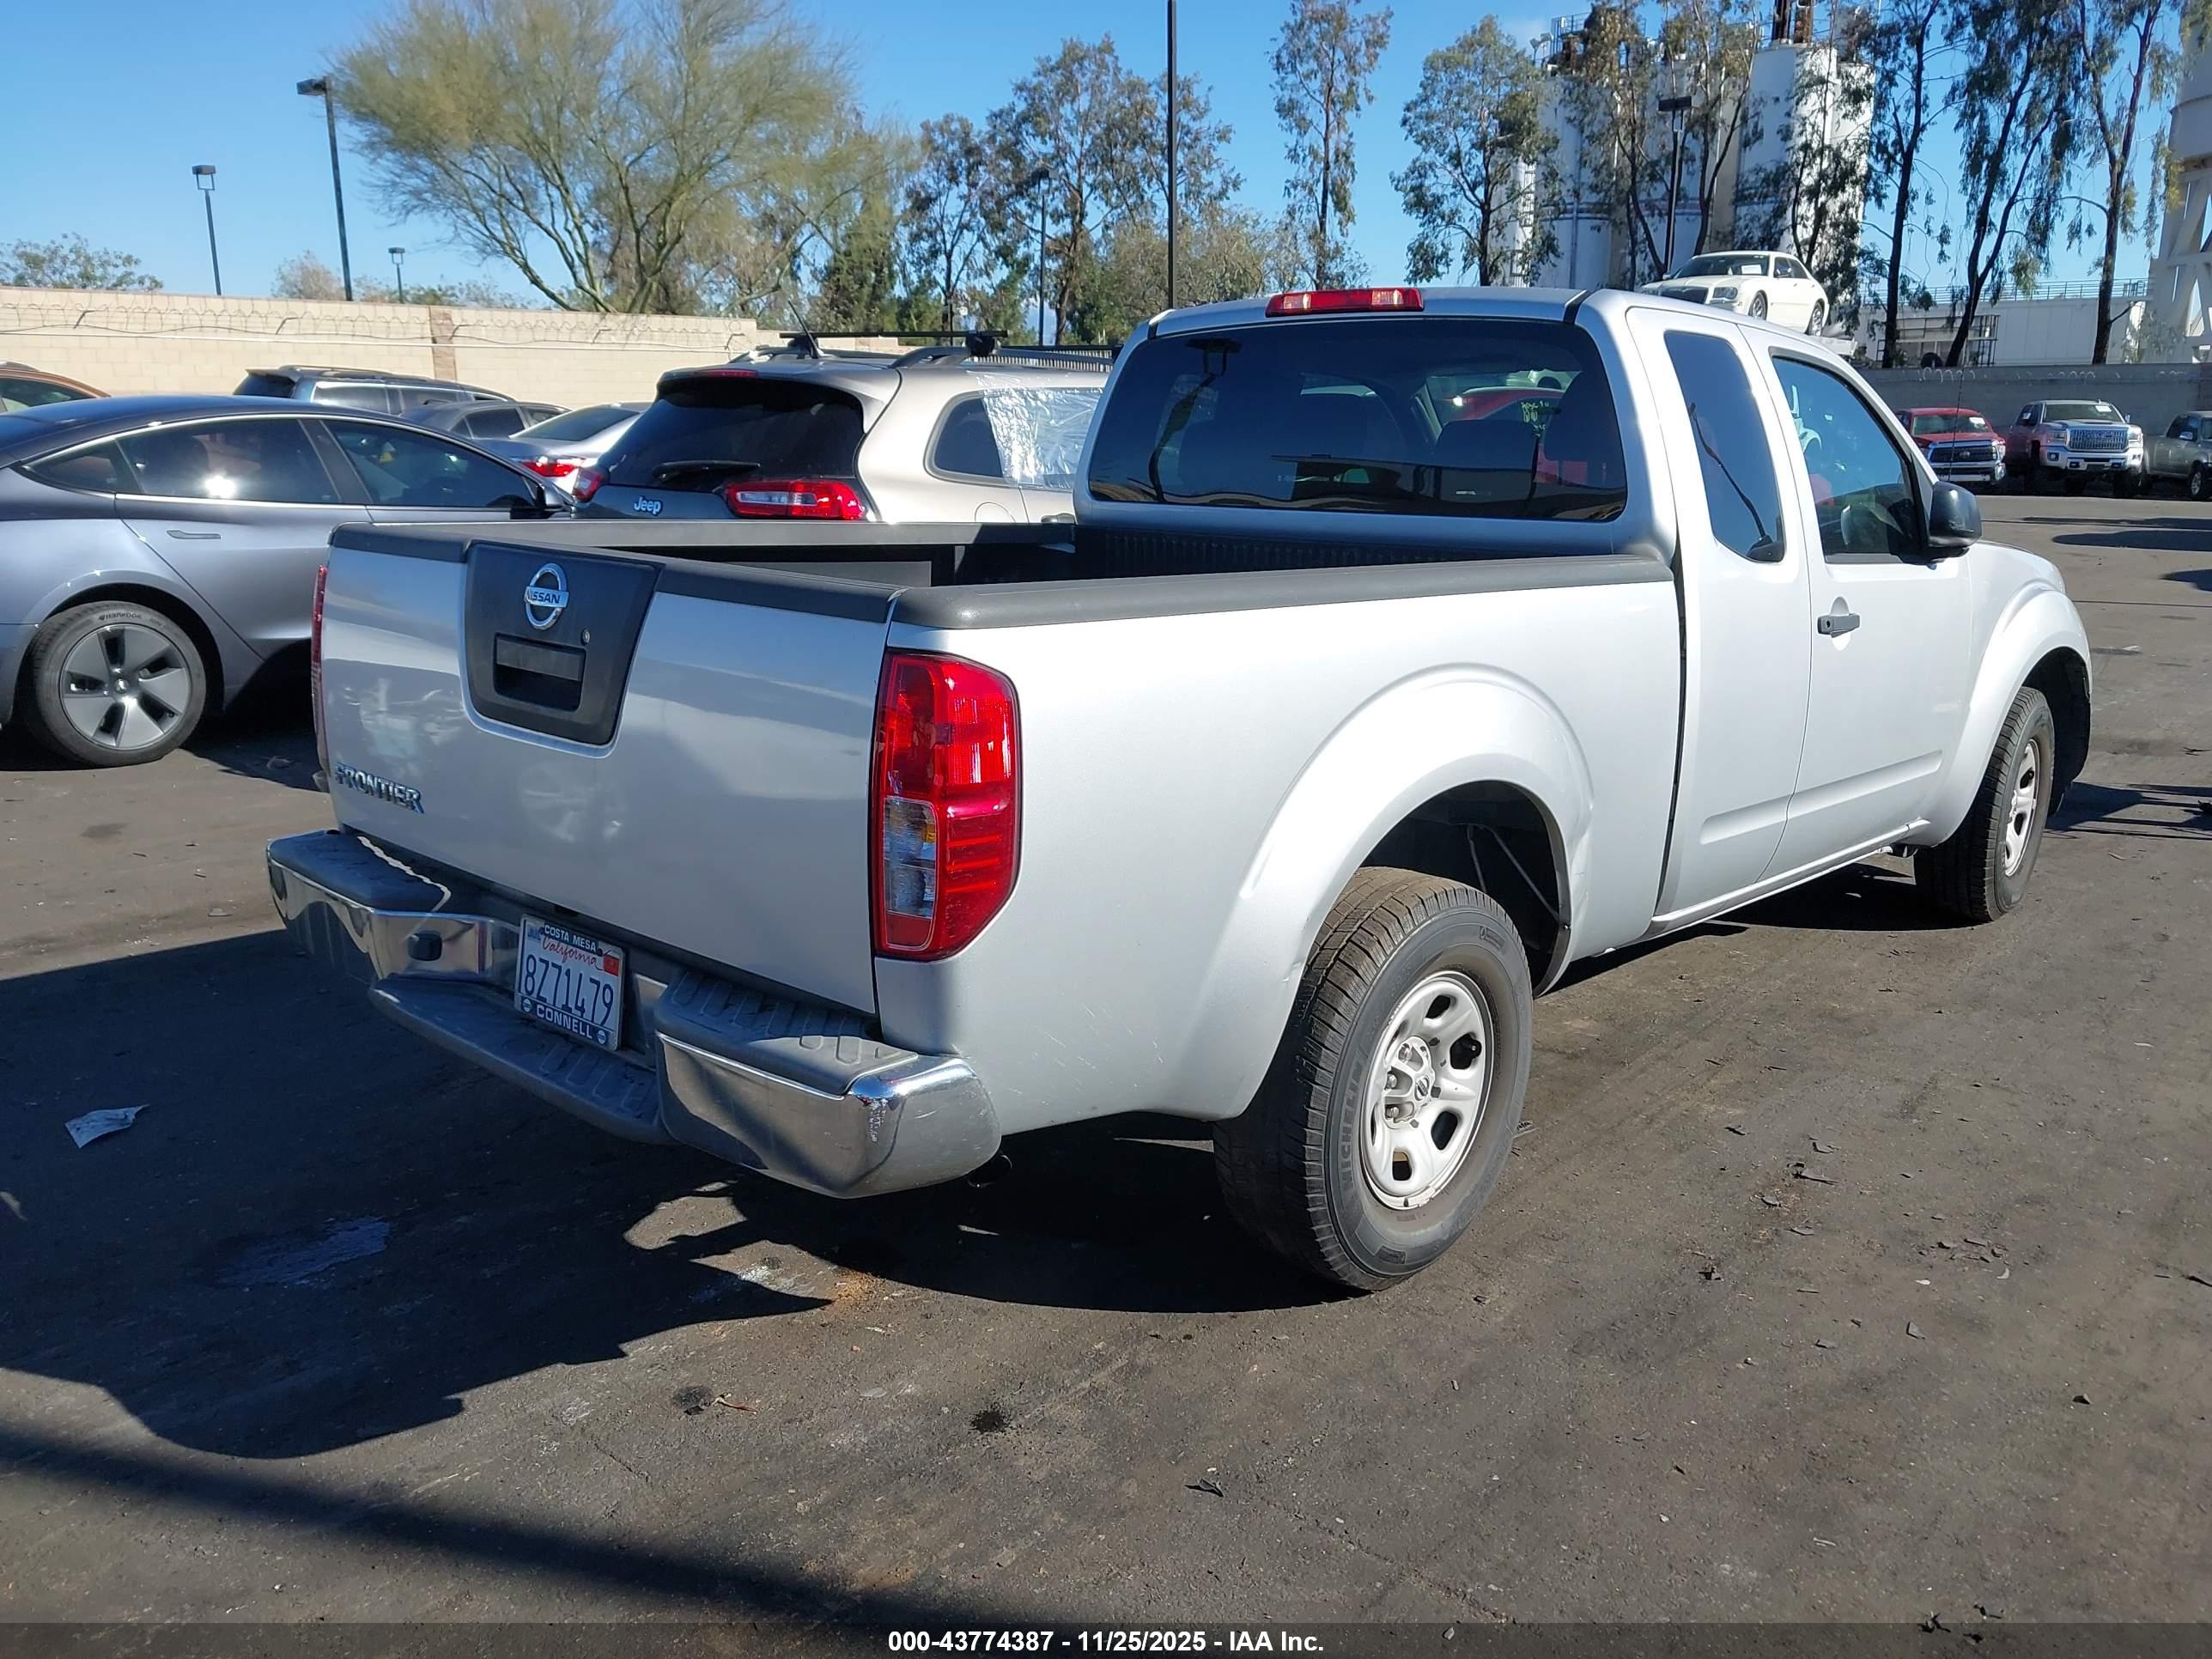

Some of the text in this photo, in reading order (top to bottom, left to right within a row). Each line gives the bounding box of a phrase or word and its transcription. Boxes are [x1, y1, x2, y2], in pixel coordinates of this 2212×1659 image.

[634, 496, 661, 515] Jeep
[527, 590, 561, 605] NISSAN
[336, 763, 424, 814] FRONTIER
[544, 925, 596, 952] COSTA MESA
[525, 954, 614, 1025] 8Z71479
[537, 1005, 592, 1039] CONNELL
